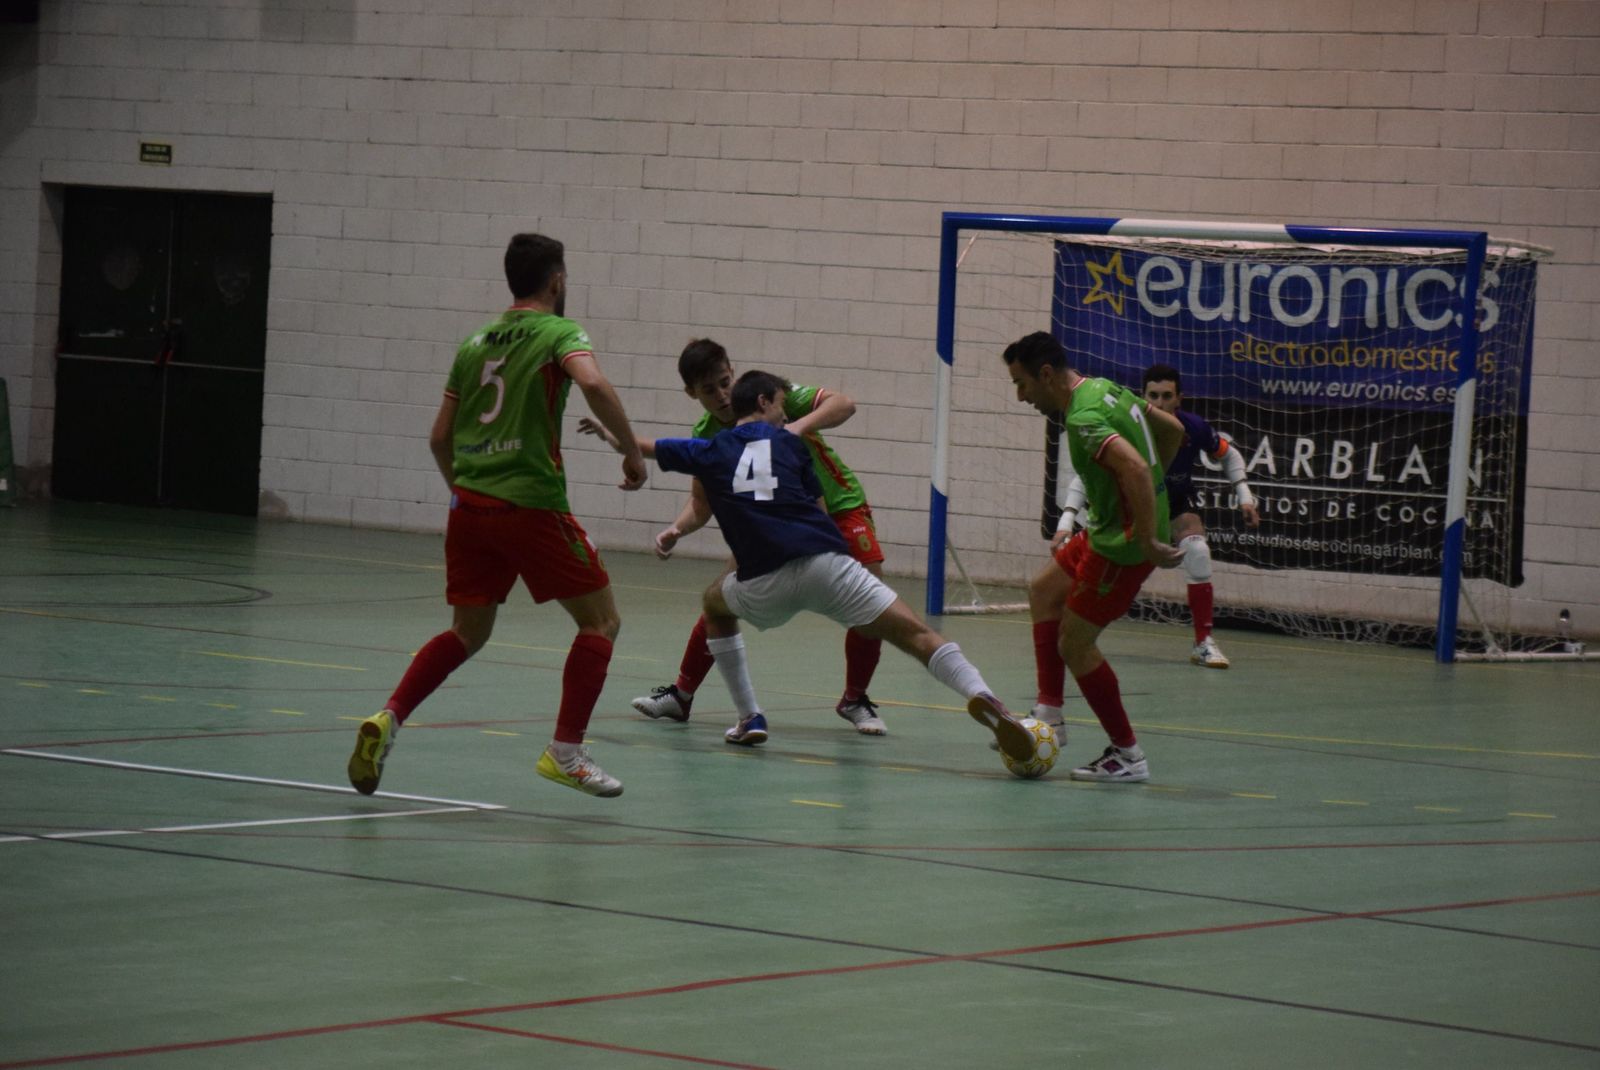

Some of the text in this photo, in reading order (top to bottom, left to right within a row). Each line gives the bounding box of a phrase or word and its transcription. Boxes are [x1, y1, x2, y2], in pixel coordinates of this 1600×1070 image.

[1137, 256, 1500, 332] euronics
[1230, 333, 1496, 373] electrodoméstics
[479, 355, 506, 424] 5
[1261, 378, 1456, 402] www.euronics.es
[733, 439, 778, 501] 4
[1188, 490, 1494, 529] STUIOS DE COCA
[1206, 531, 1473, 563] ww.estudiosdecocinagarblan.m
